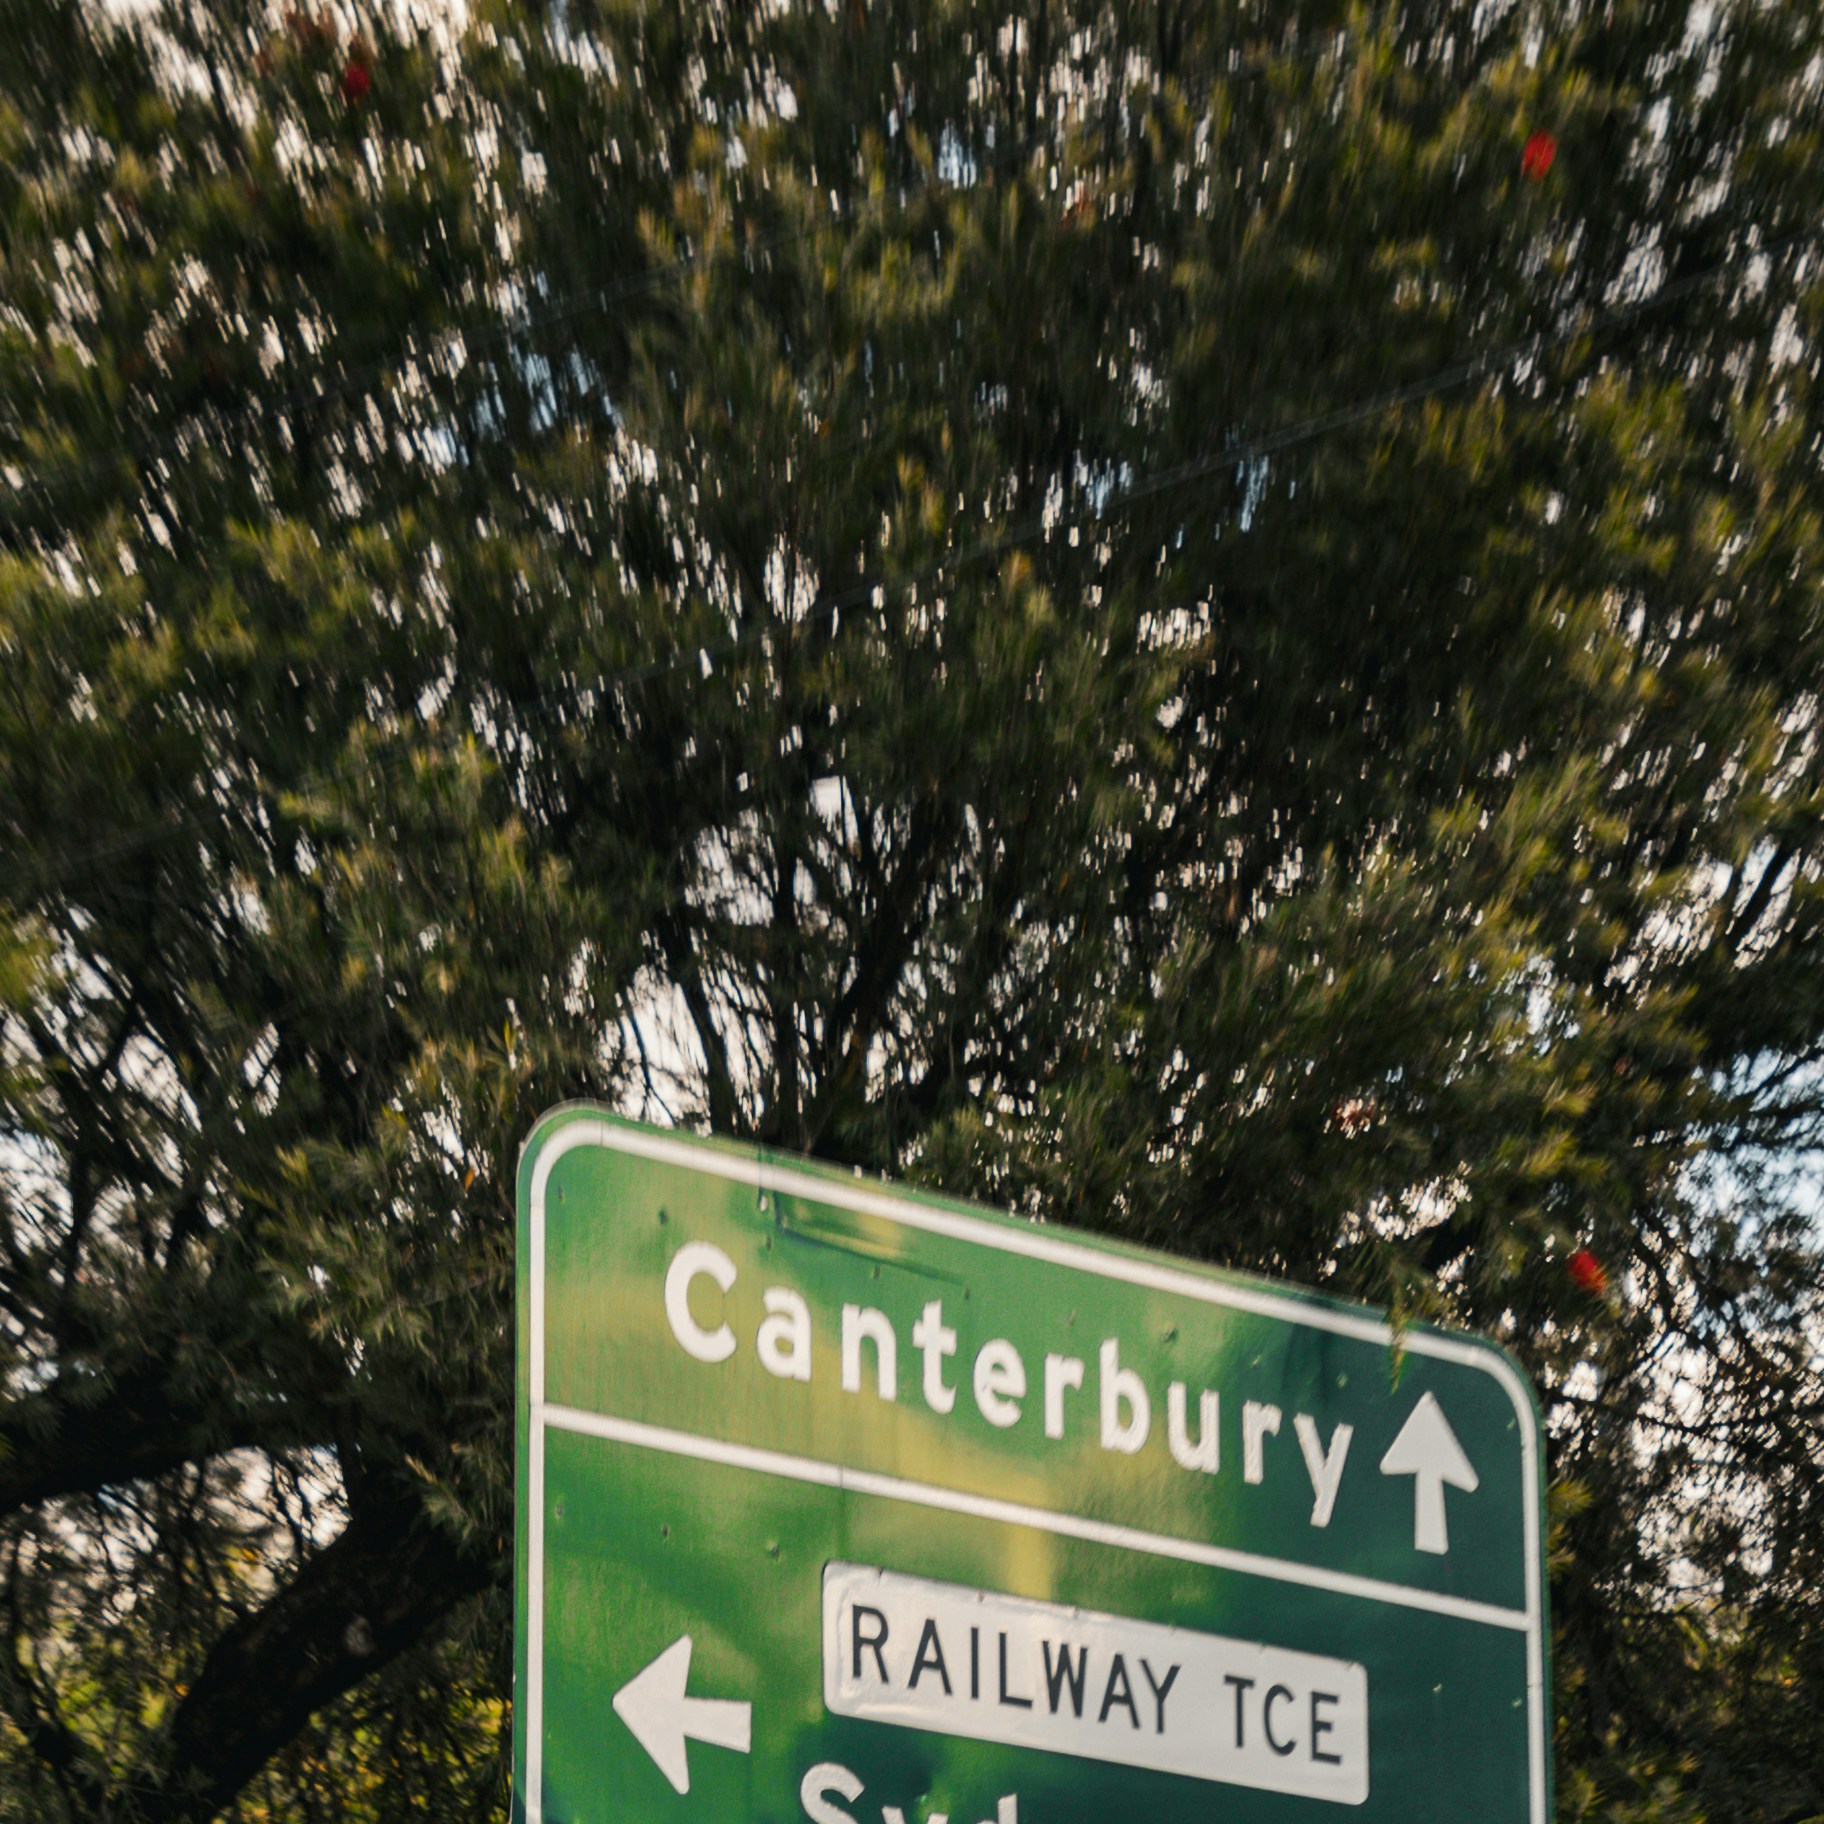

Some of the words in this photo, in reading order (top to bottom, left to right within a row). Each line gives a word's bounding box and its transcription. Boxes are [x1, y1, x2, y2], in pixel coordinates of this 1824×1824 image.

[665, 1241, 1354, 1528] Canterbury
[851, 1604, 1182, 1736] RAILWAY
[1223, 1675, 1343, 1766] TCE
